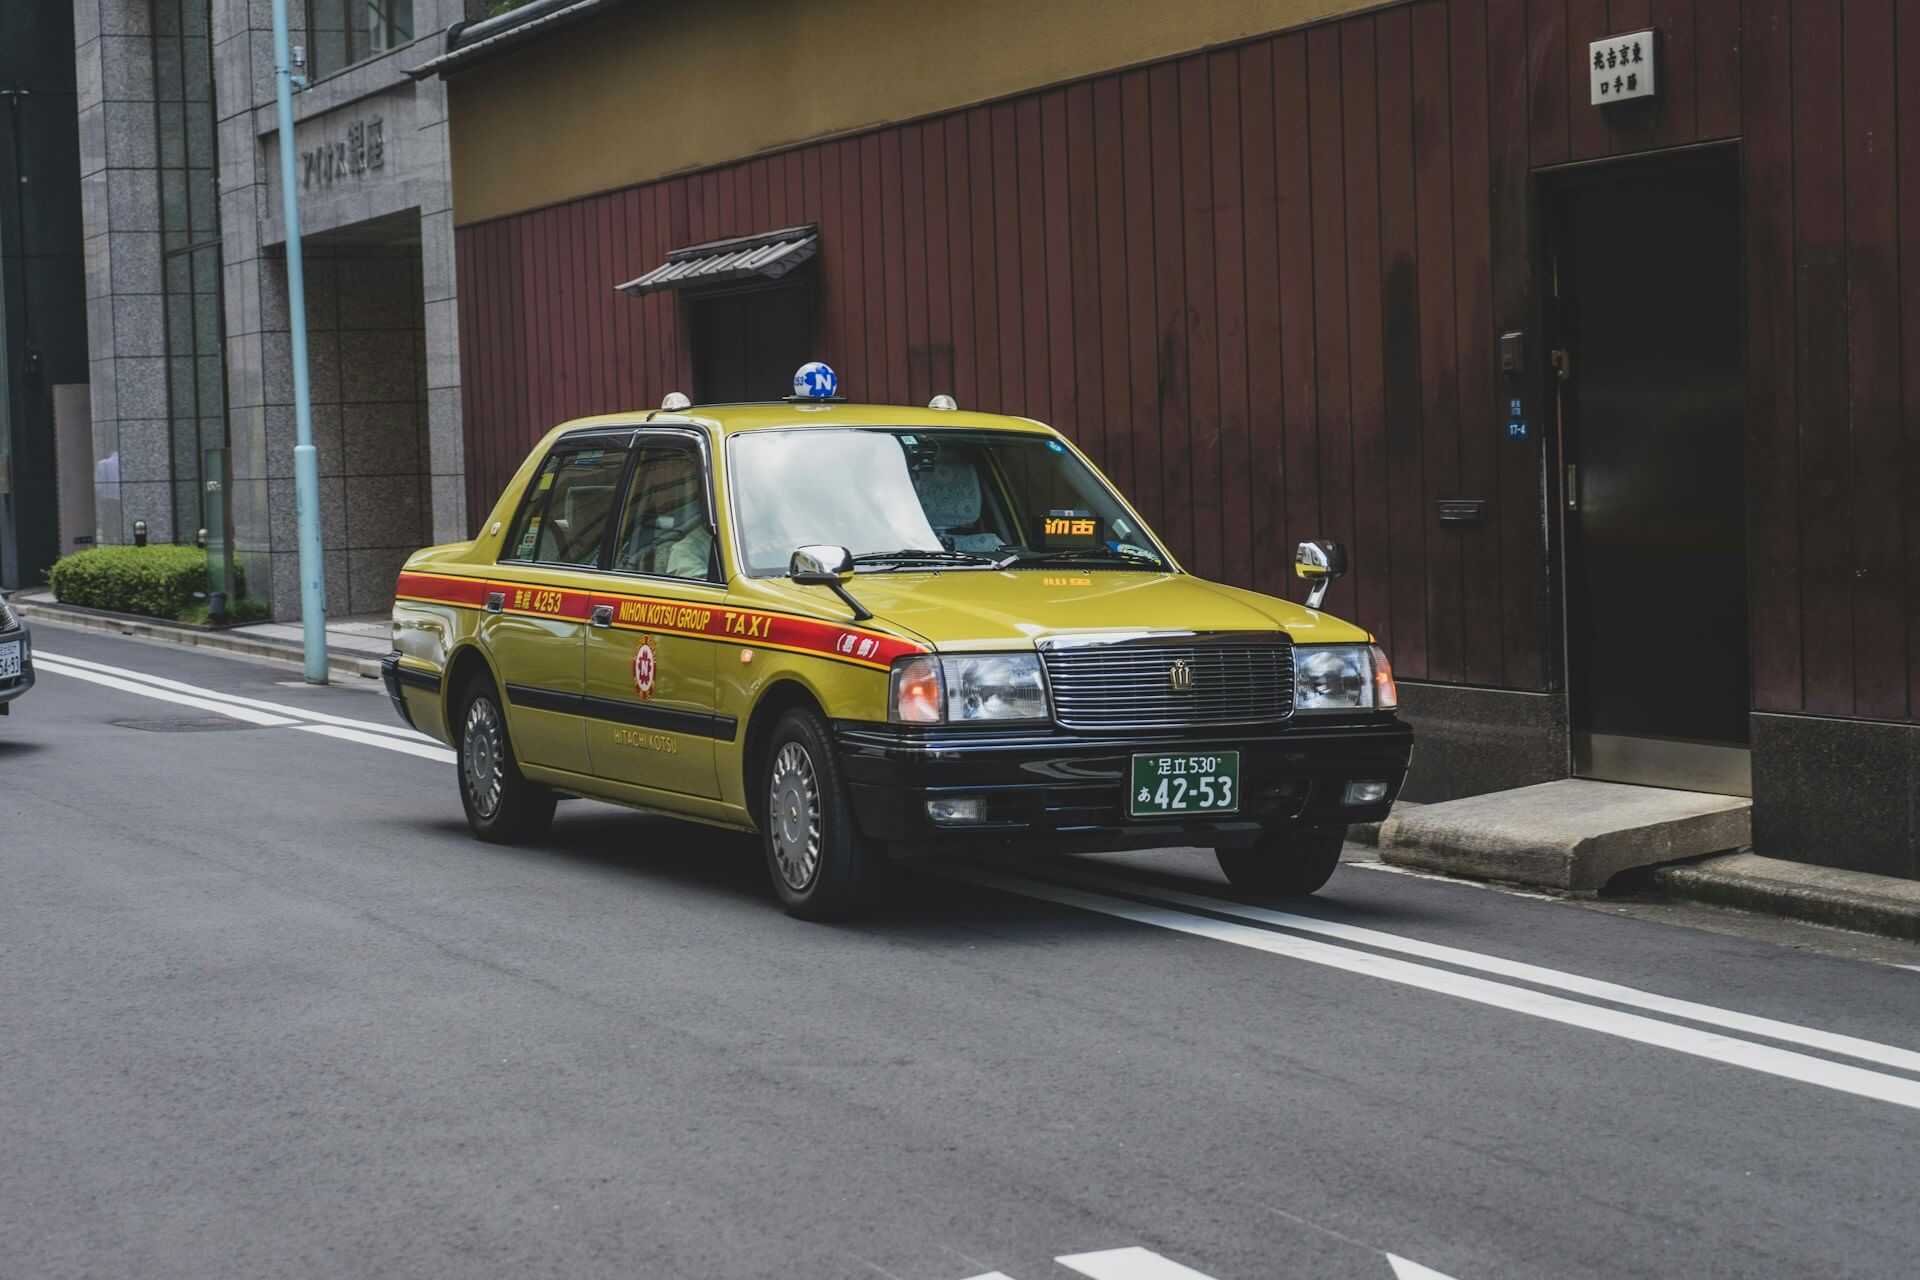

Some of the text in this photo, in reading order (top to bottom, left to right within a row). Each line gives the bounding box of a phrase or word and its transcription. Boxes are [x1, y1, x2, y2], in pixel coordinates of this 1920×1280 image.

[815, 373, 832, 391] N
[534, 591, 562, 613] 4253
[619, 601, 772, 638] NIHON KOTSU GROUP TAXI
[614, 729, 678, 754] HITACHI KOTSU
[1157, 757, 1216, 775] 足立 530
[1137, 775, 1232, 809] あ 42-53
